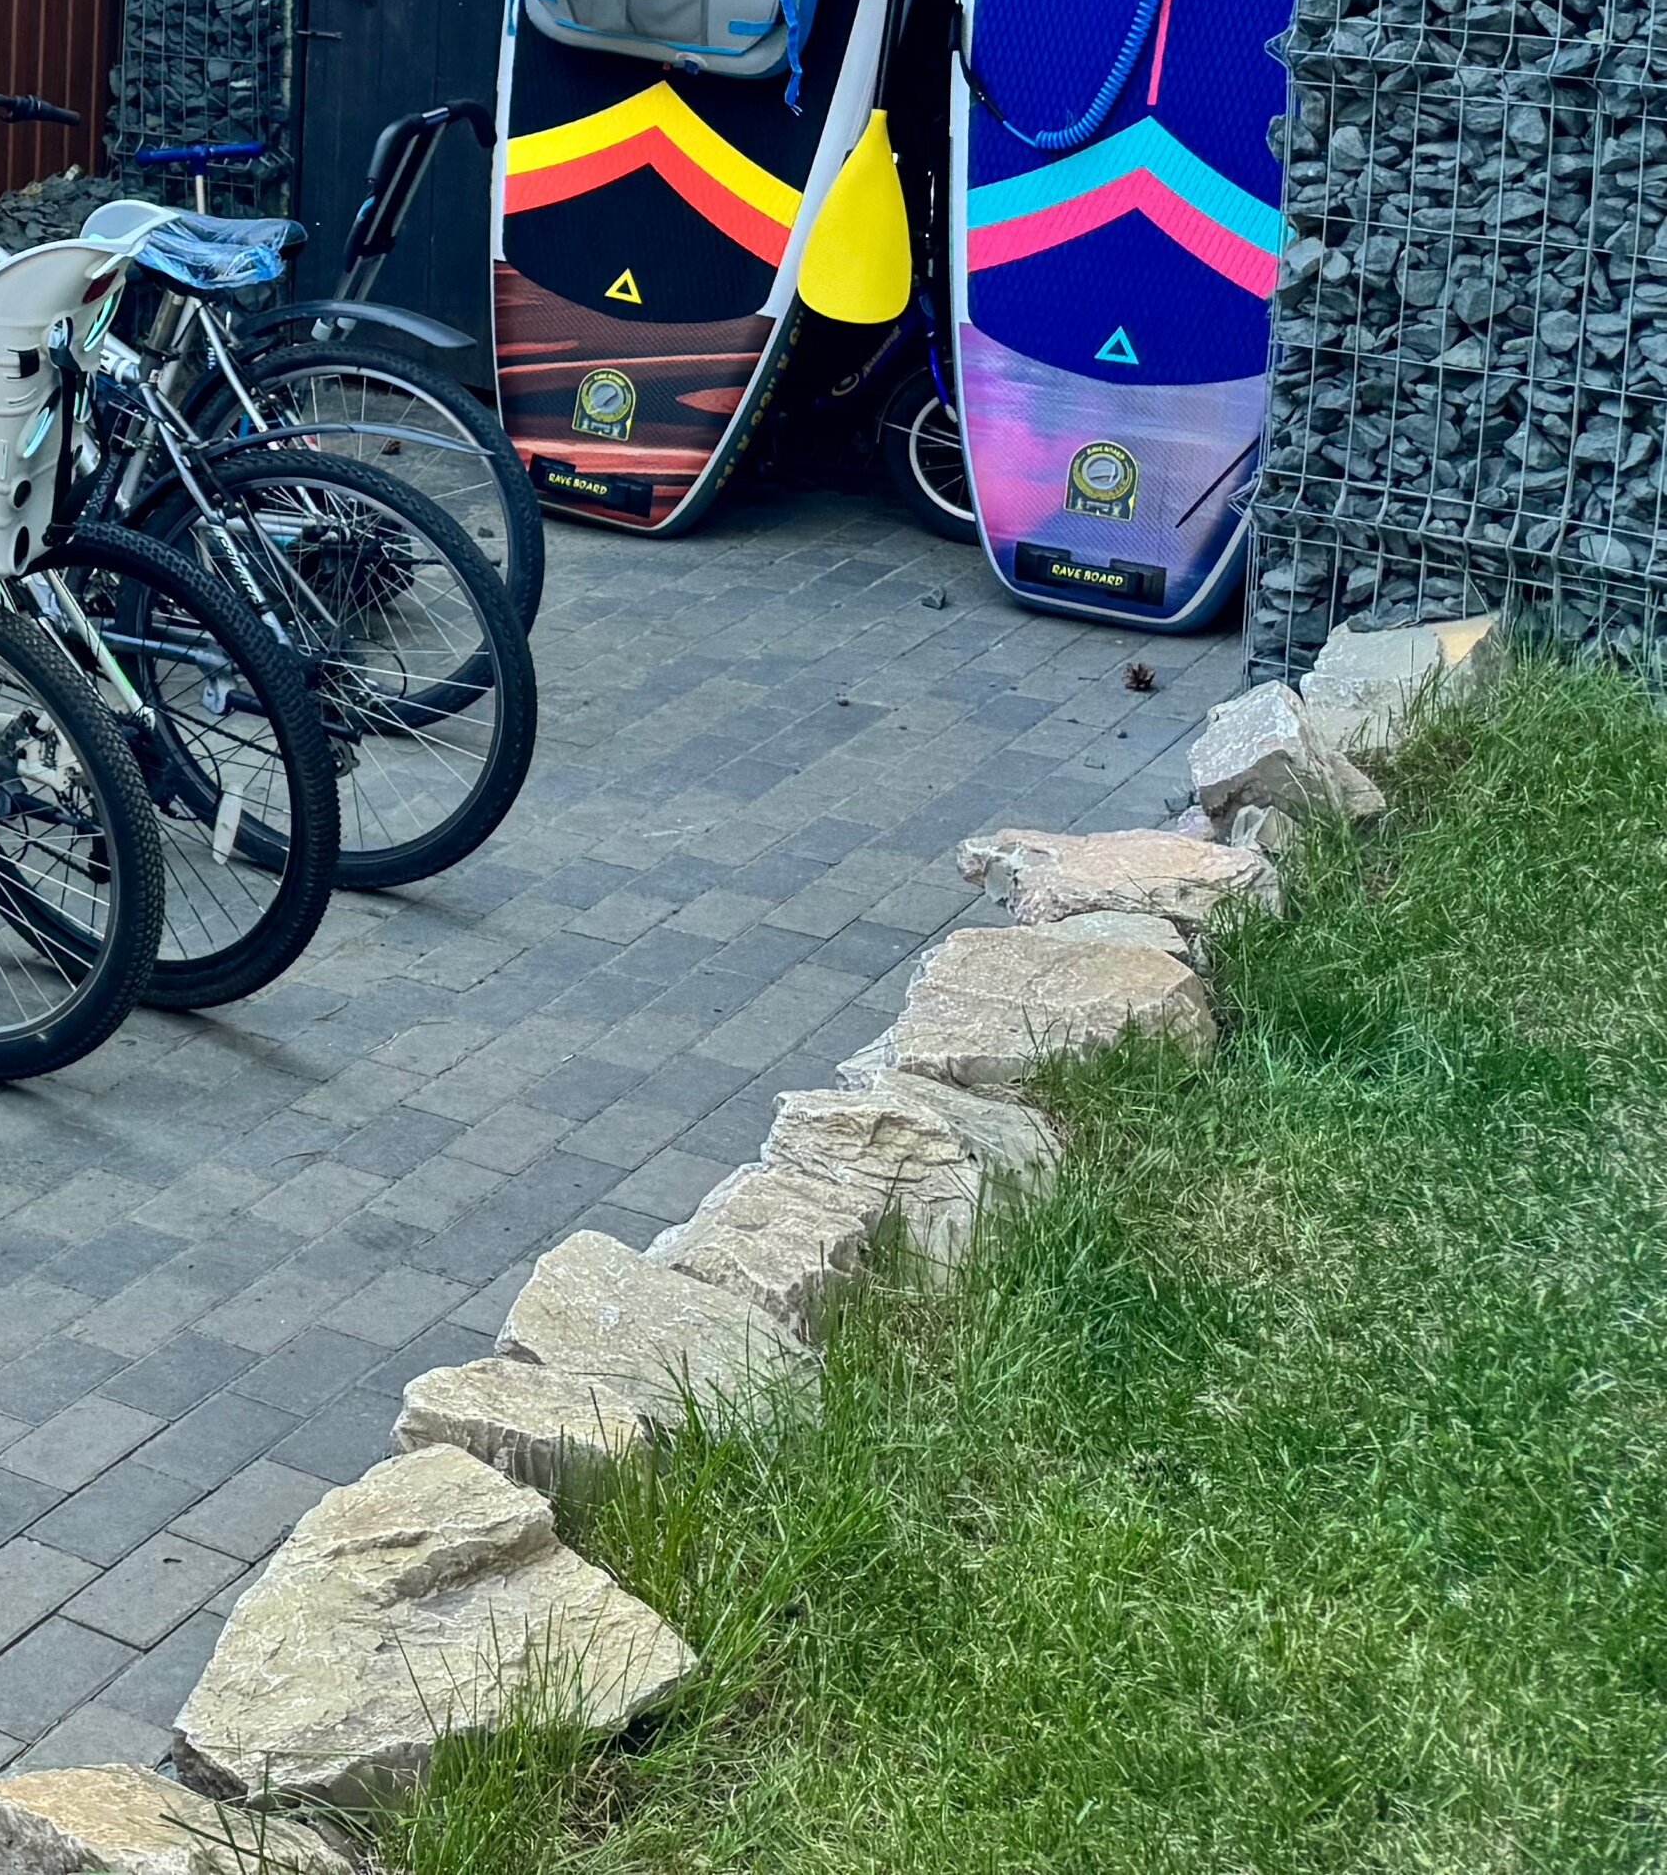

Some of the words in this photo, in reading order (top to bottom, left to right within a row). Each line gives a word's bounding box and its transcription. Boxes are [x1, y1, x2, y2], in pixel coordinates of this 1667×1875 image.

[548, 472, 572, 487] RAVE
[573, 477, 609, 496] BOARD
[1051, 563, 1084, 580] RAVE
[1083, 570, 1125, 588] BOARD
